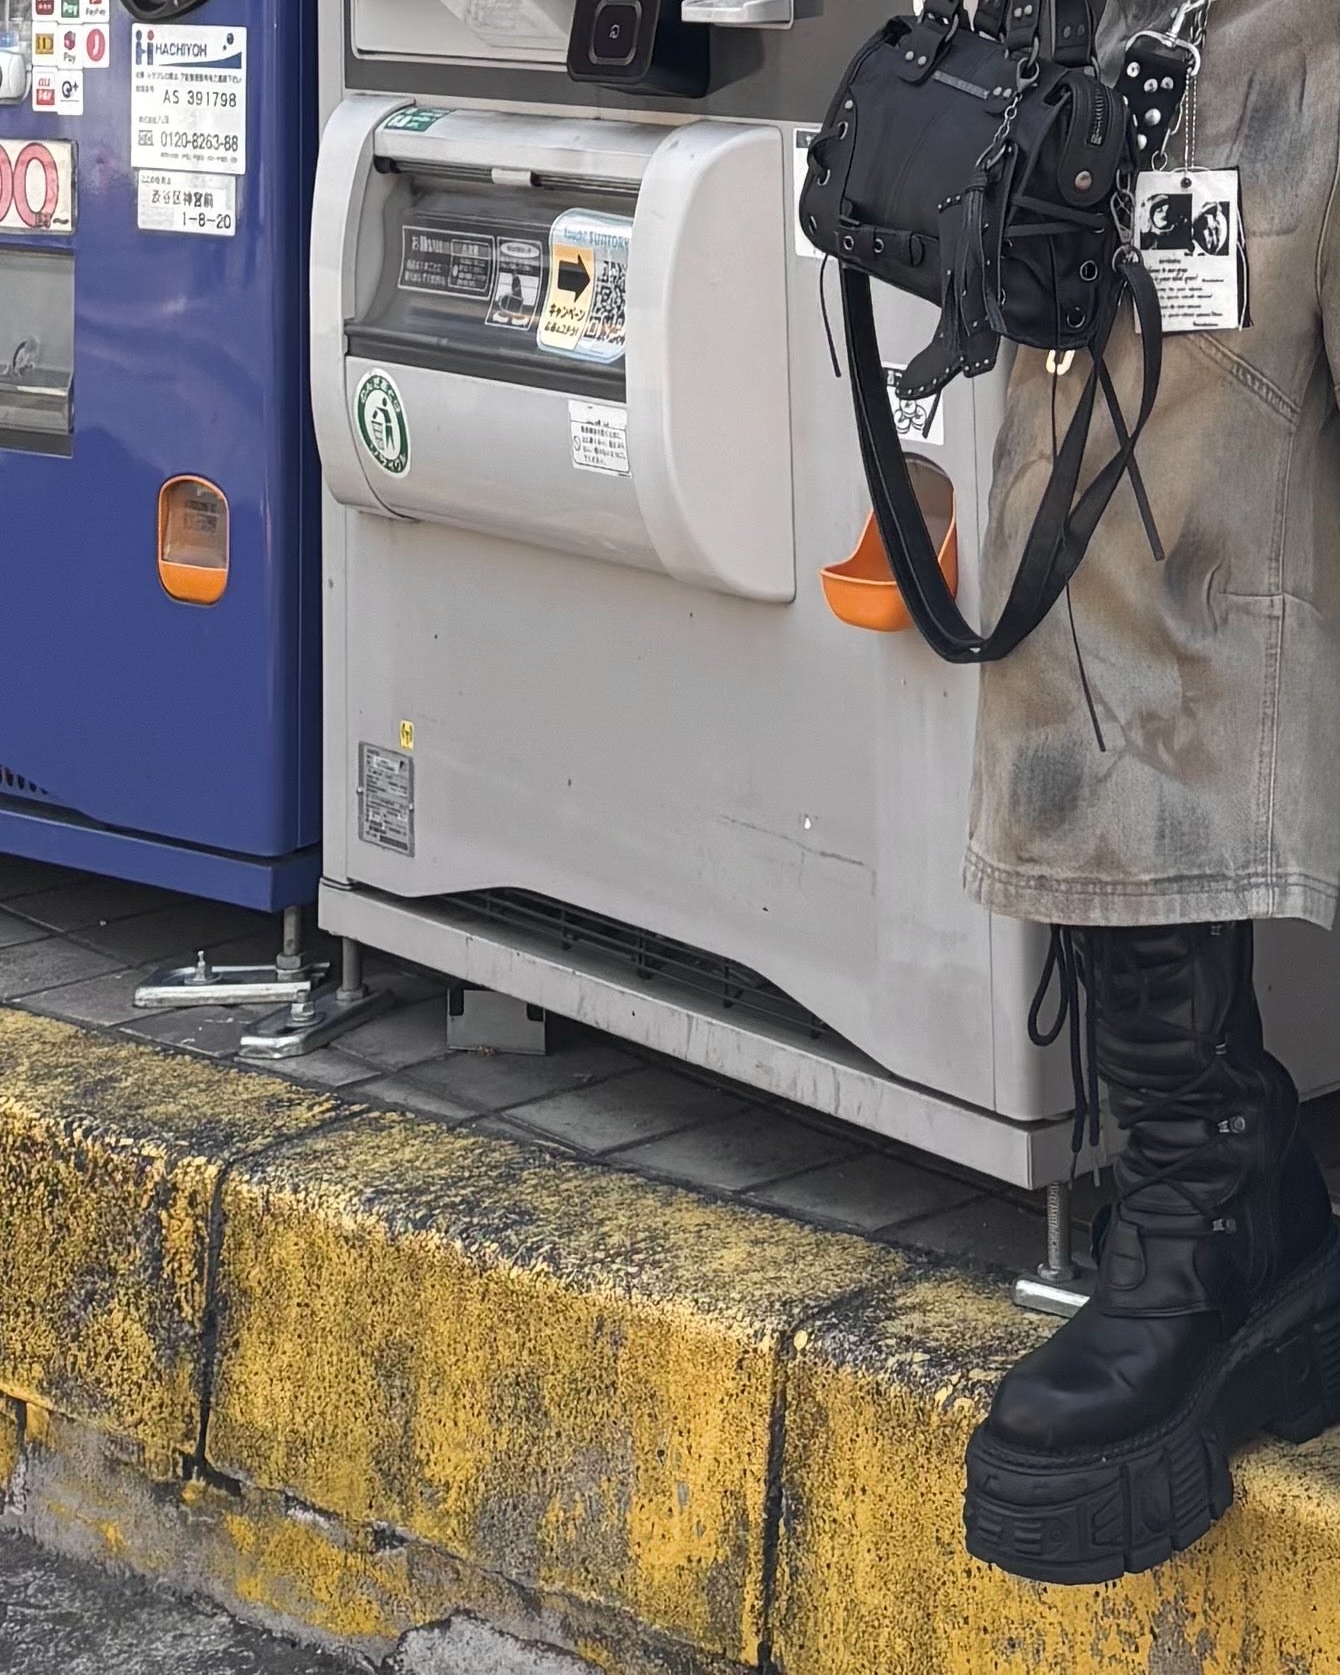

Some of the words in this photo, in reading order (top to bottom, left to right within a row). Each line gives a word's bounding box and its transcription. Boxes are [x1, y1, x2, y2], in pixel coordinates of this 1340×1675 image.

[156, 43, 207, 57] HACHIYOH
[163, 90, 180, 105] AS
[187, 90, 237, 107] 391798
[161, 132, 239, 152] 0120-8263-88
[182, 212, 232, 229] 1-8-20
[589, 231, 630, 248] SUNTORY
[548, 304, 586, 321] キャンペーン
